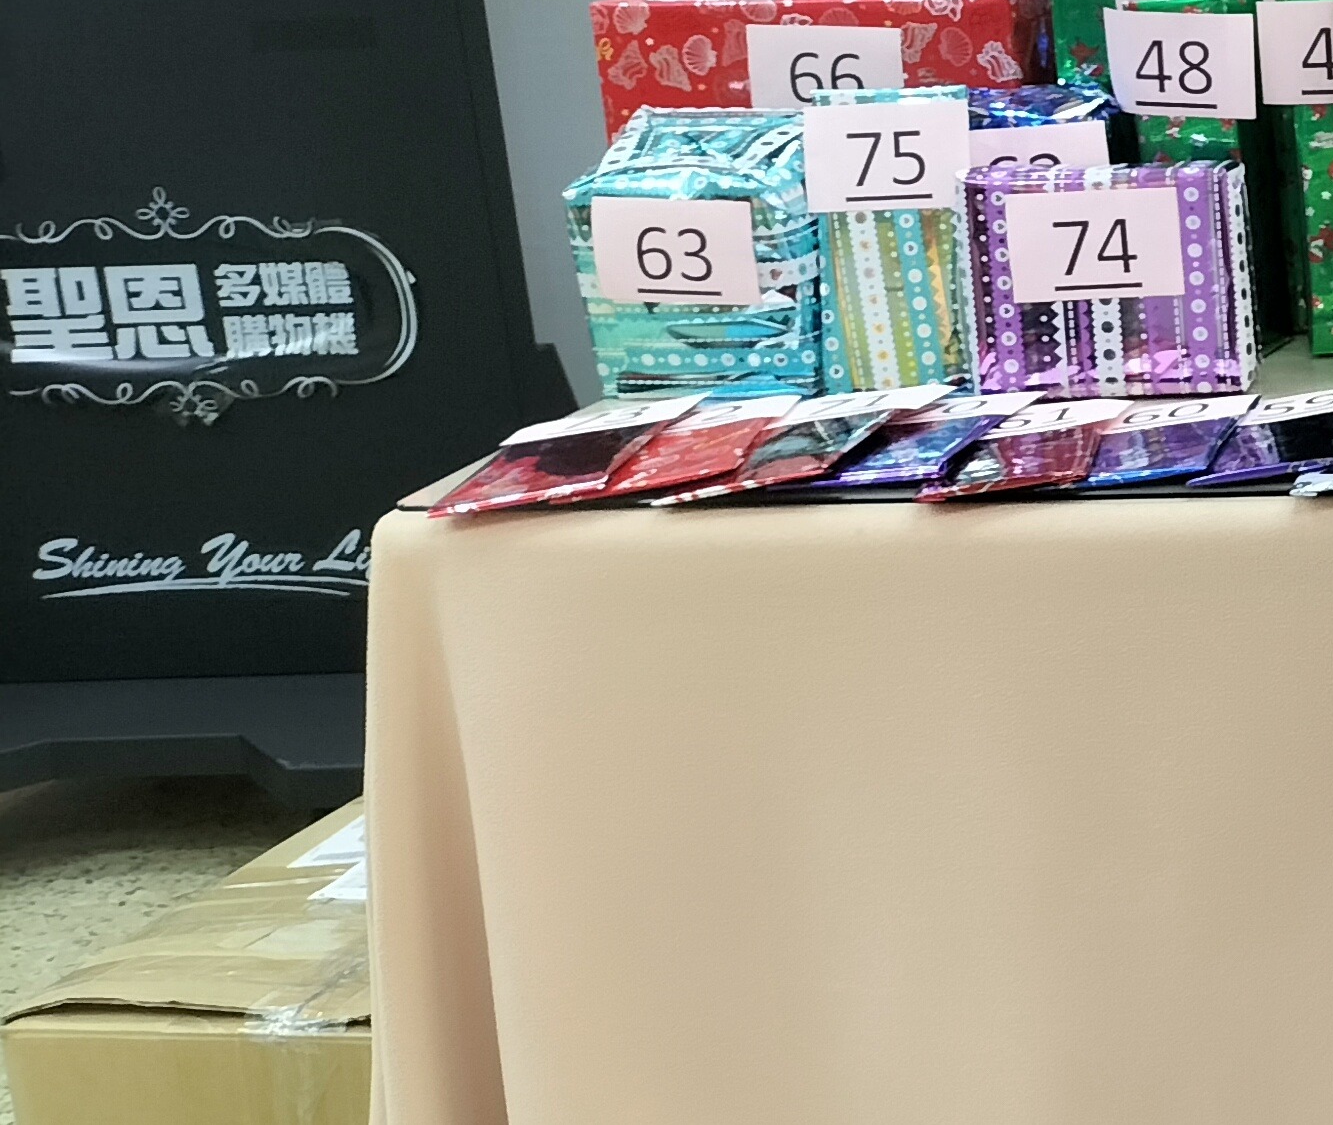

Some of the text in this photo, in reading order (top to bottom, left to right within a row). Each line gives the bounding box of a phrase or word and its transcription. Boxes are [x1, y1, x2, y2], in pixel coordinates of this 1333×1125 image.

[789, 52, 865, 104] 66
[1135, 39, 1213, 95] 48
[846, 129, 926, 187] 75
[635, 225, 715, 282] 63
[1052, 217, 1139, 277] 74
[213, 261, 354, 308] 多媒體
[3, 263, 216, 364] 聖恩
[223, 312, 359, 361] 購物機
[1122, 402, 1210, 425] 60
[32, 528, 372, 583] Shining Your Li
